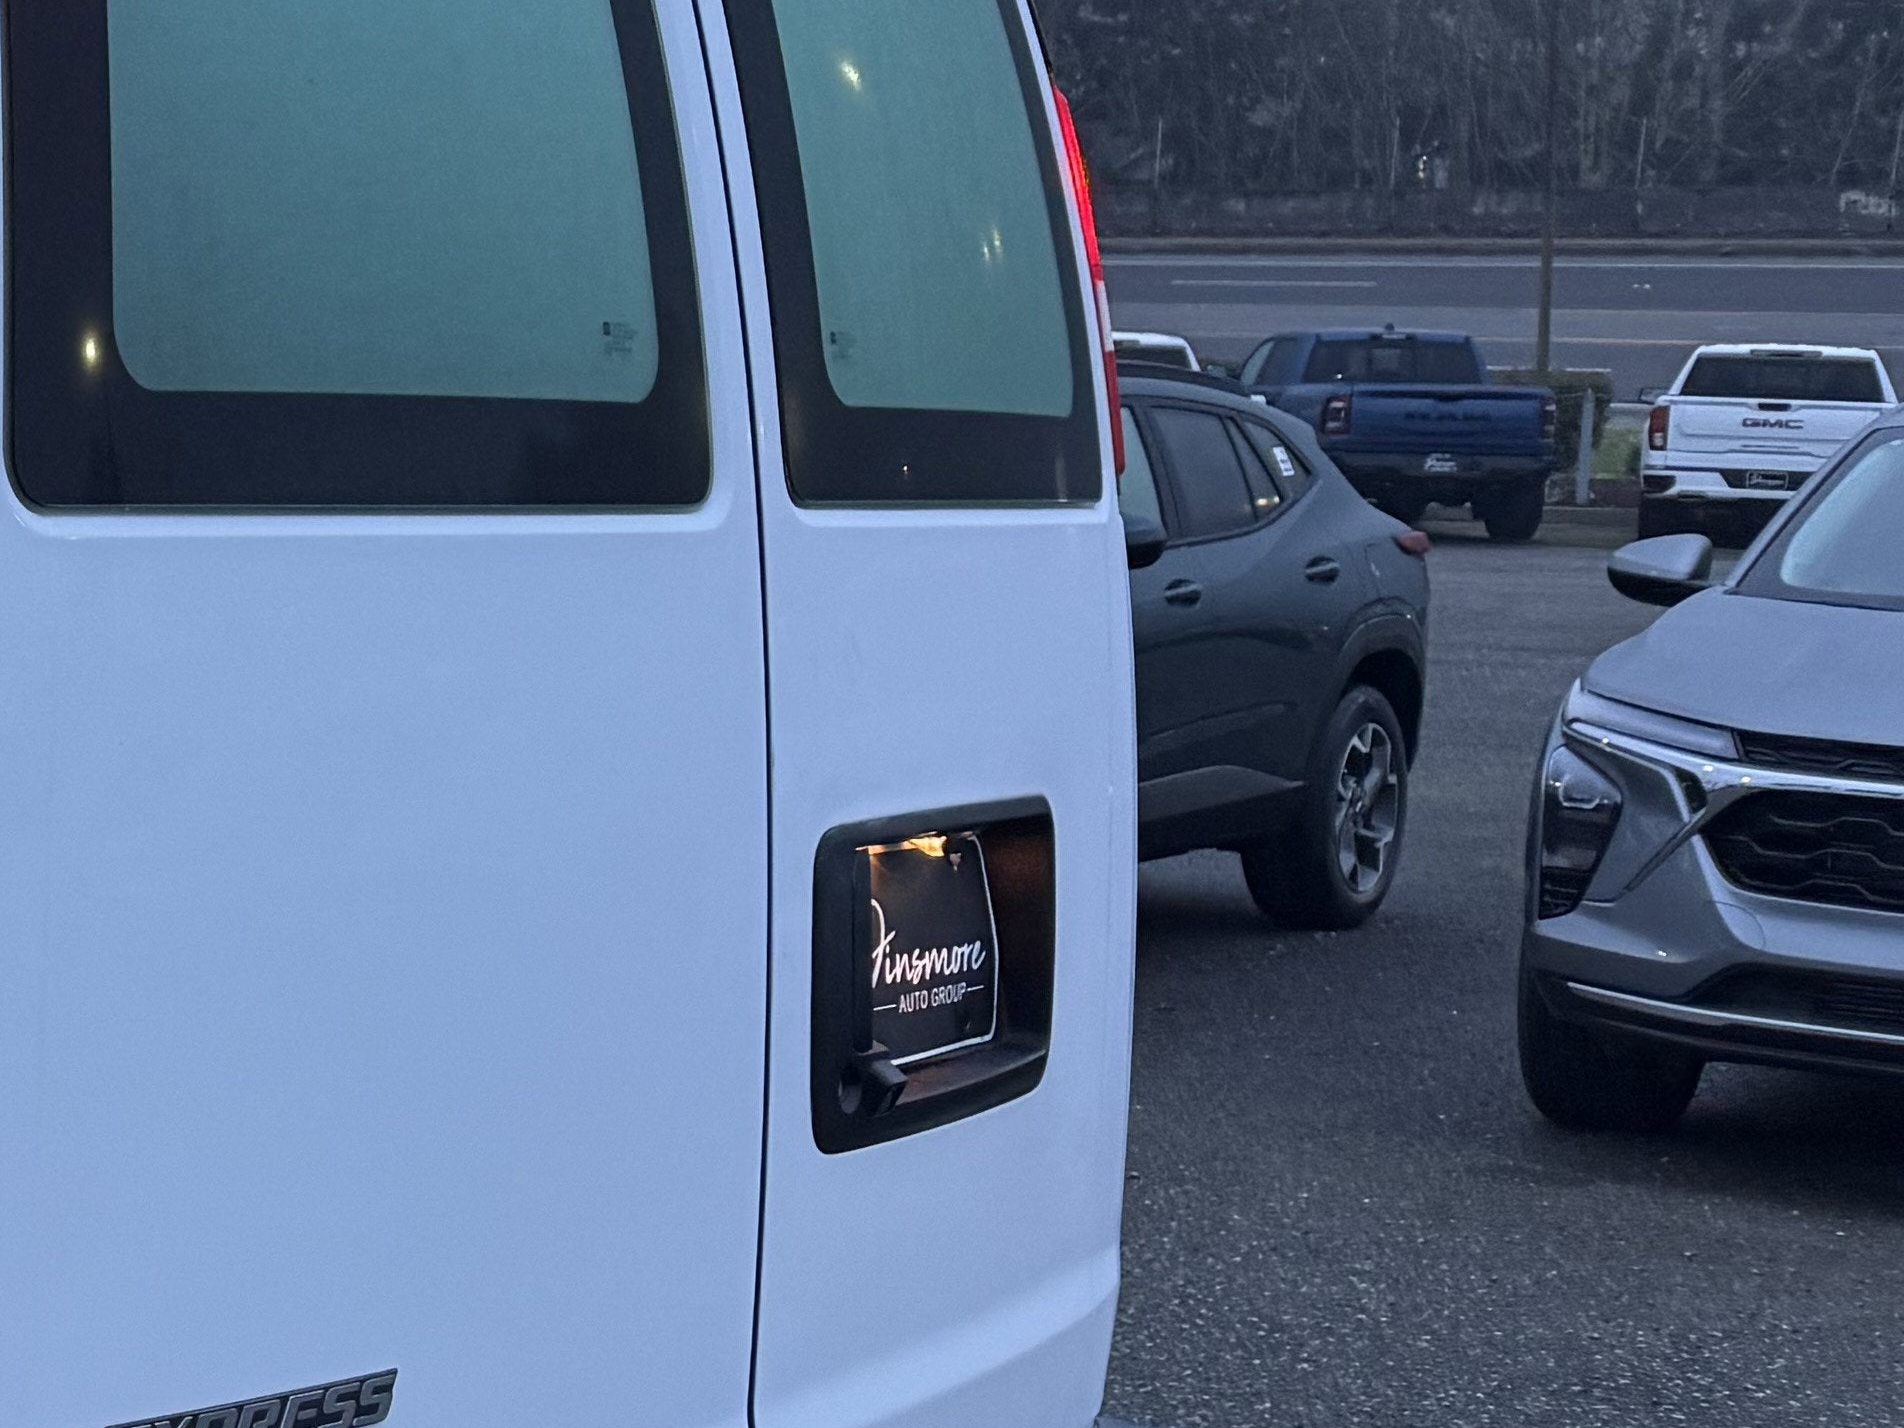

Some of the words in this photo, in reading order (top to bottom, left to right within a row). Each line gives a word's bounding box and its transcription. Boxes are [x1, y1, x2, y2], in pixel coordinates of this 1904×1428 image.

[1741, 417, 1805, 430] GMC
[898, 989, 929, 1013] AUTO
[930, 980, 967, 1007] GROUP
